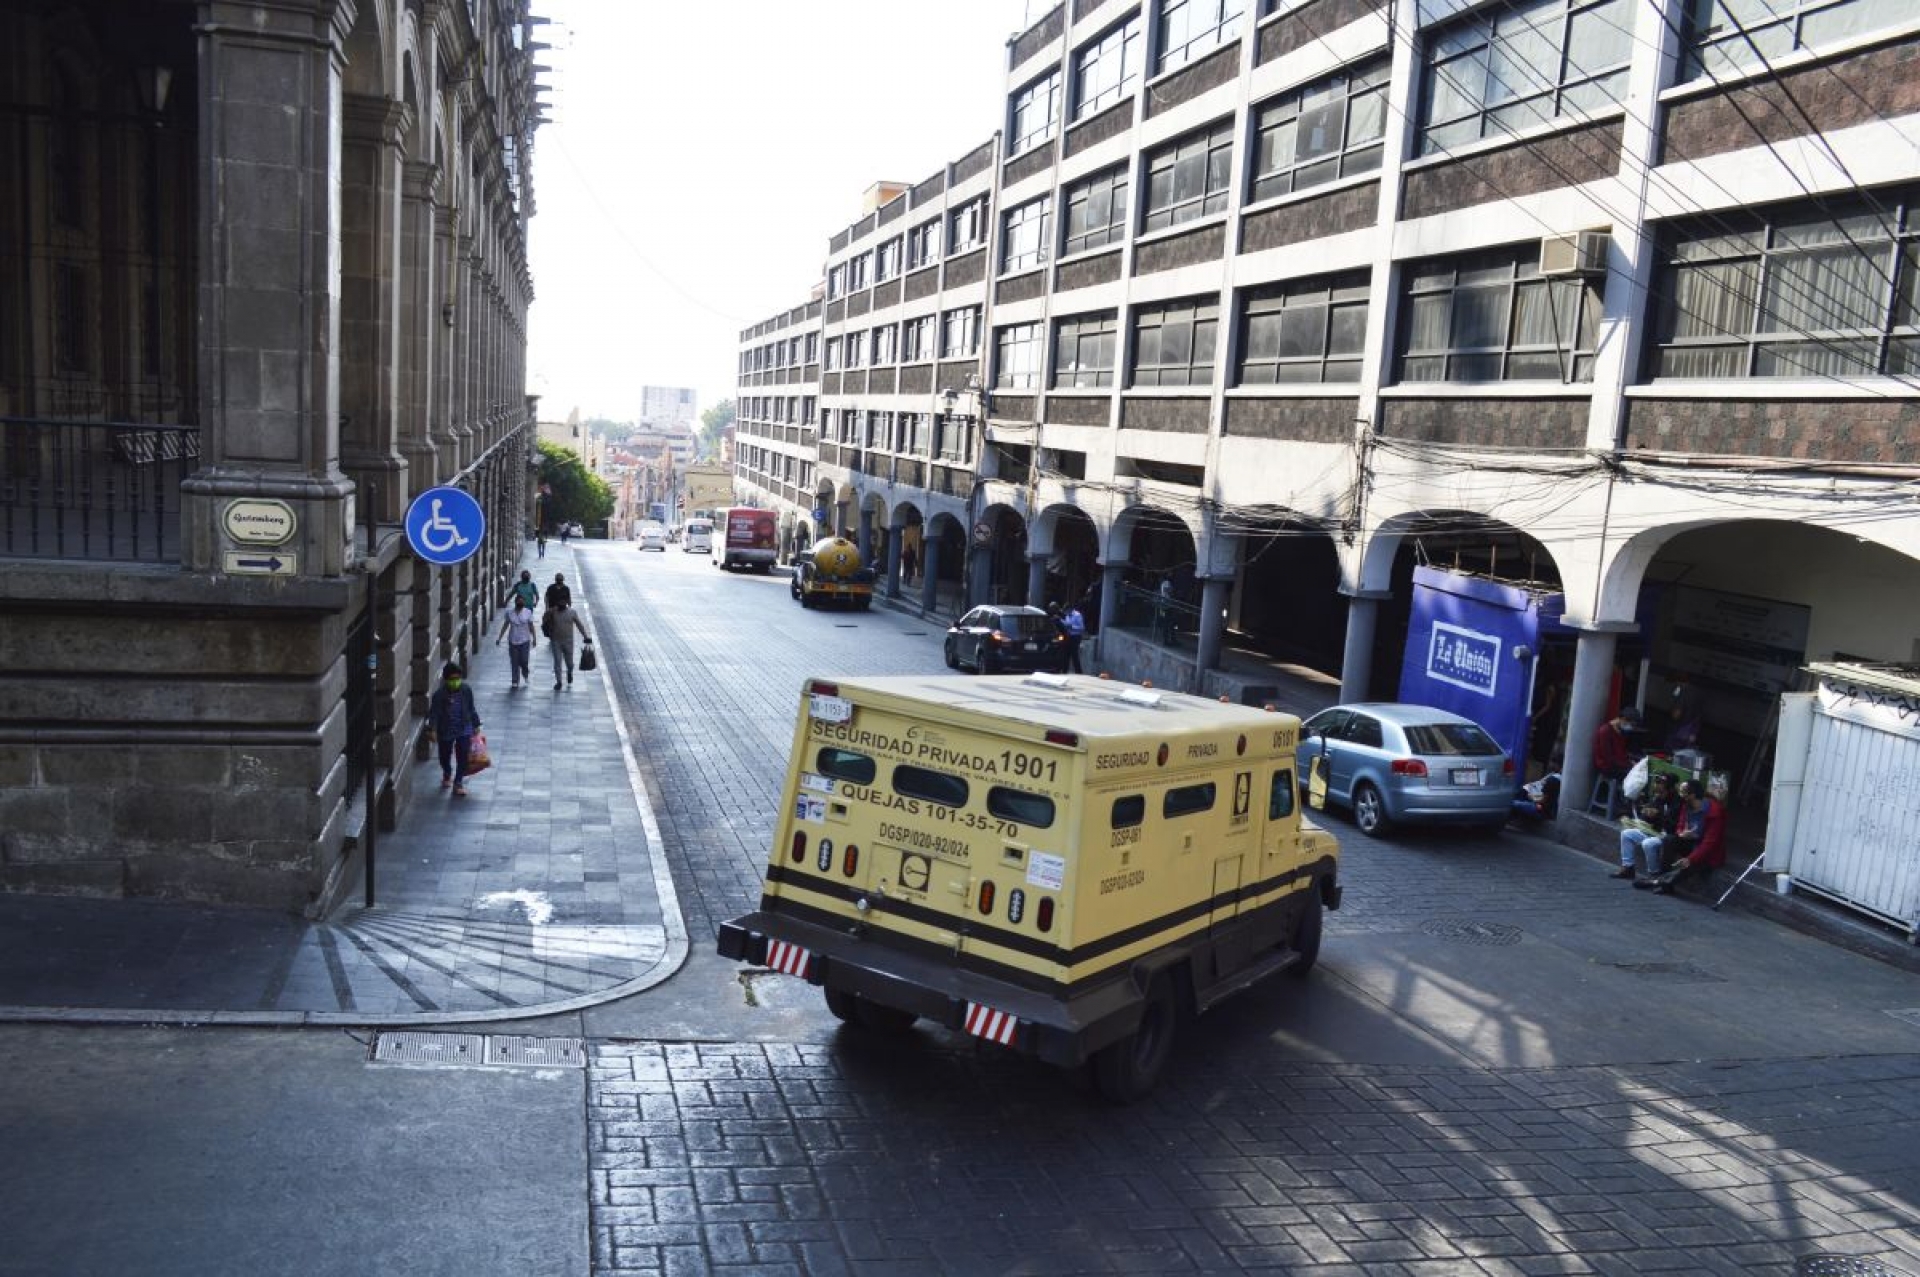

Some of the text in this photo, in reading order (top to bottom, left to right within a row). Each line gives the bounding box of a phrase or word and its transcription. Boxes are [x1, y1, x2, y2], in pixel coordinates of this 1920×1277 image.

[1435, 635, 1452, 664] La
[1453, 639, 1492, 676] Unión
[813, 721, 913, 755] SEGURIDAD
[918, 743, 998, 775] PRIVADA
[1001, 750, 1057, 782] 1901
[1096, 743, 1218, 769] SEGURIDAD PRIVADA
[842, 784, 920, 814] QUEJAS
[925, 804, 1018, 837] 101-35-70
[879, 822, 969, 857] DGSP/020-92/024
